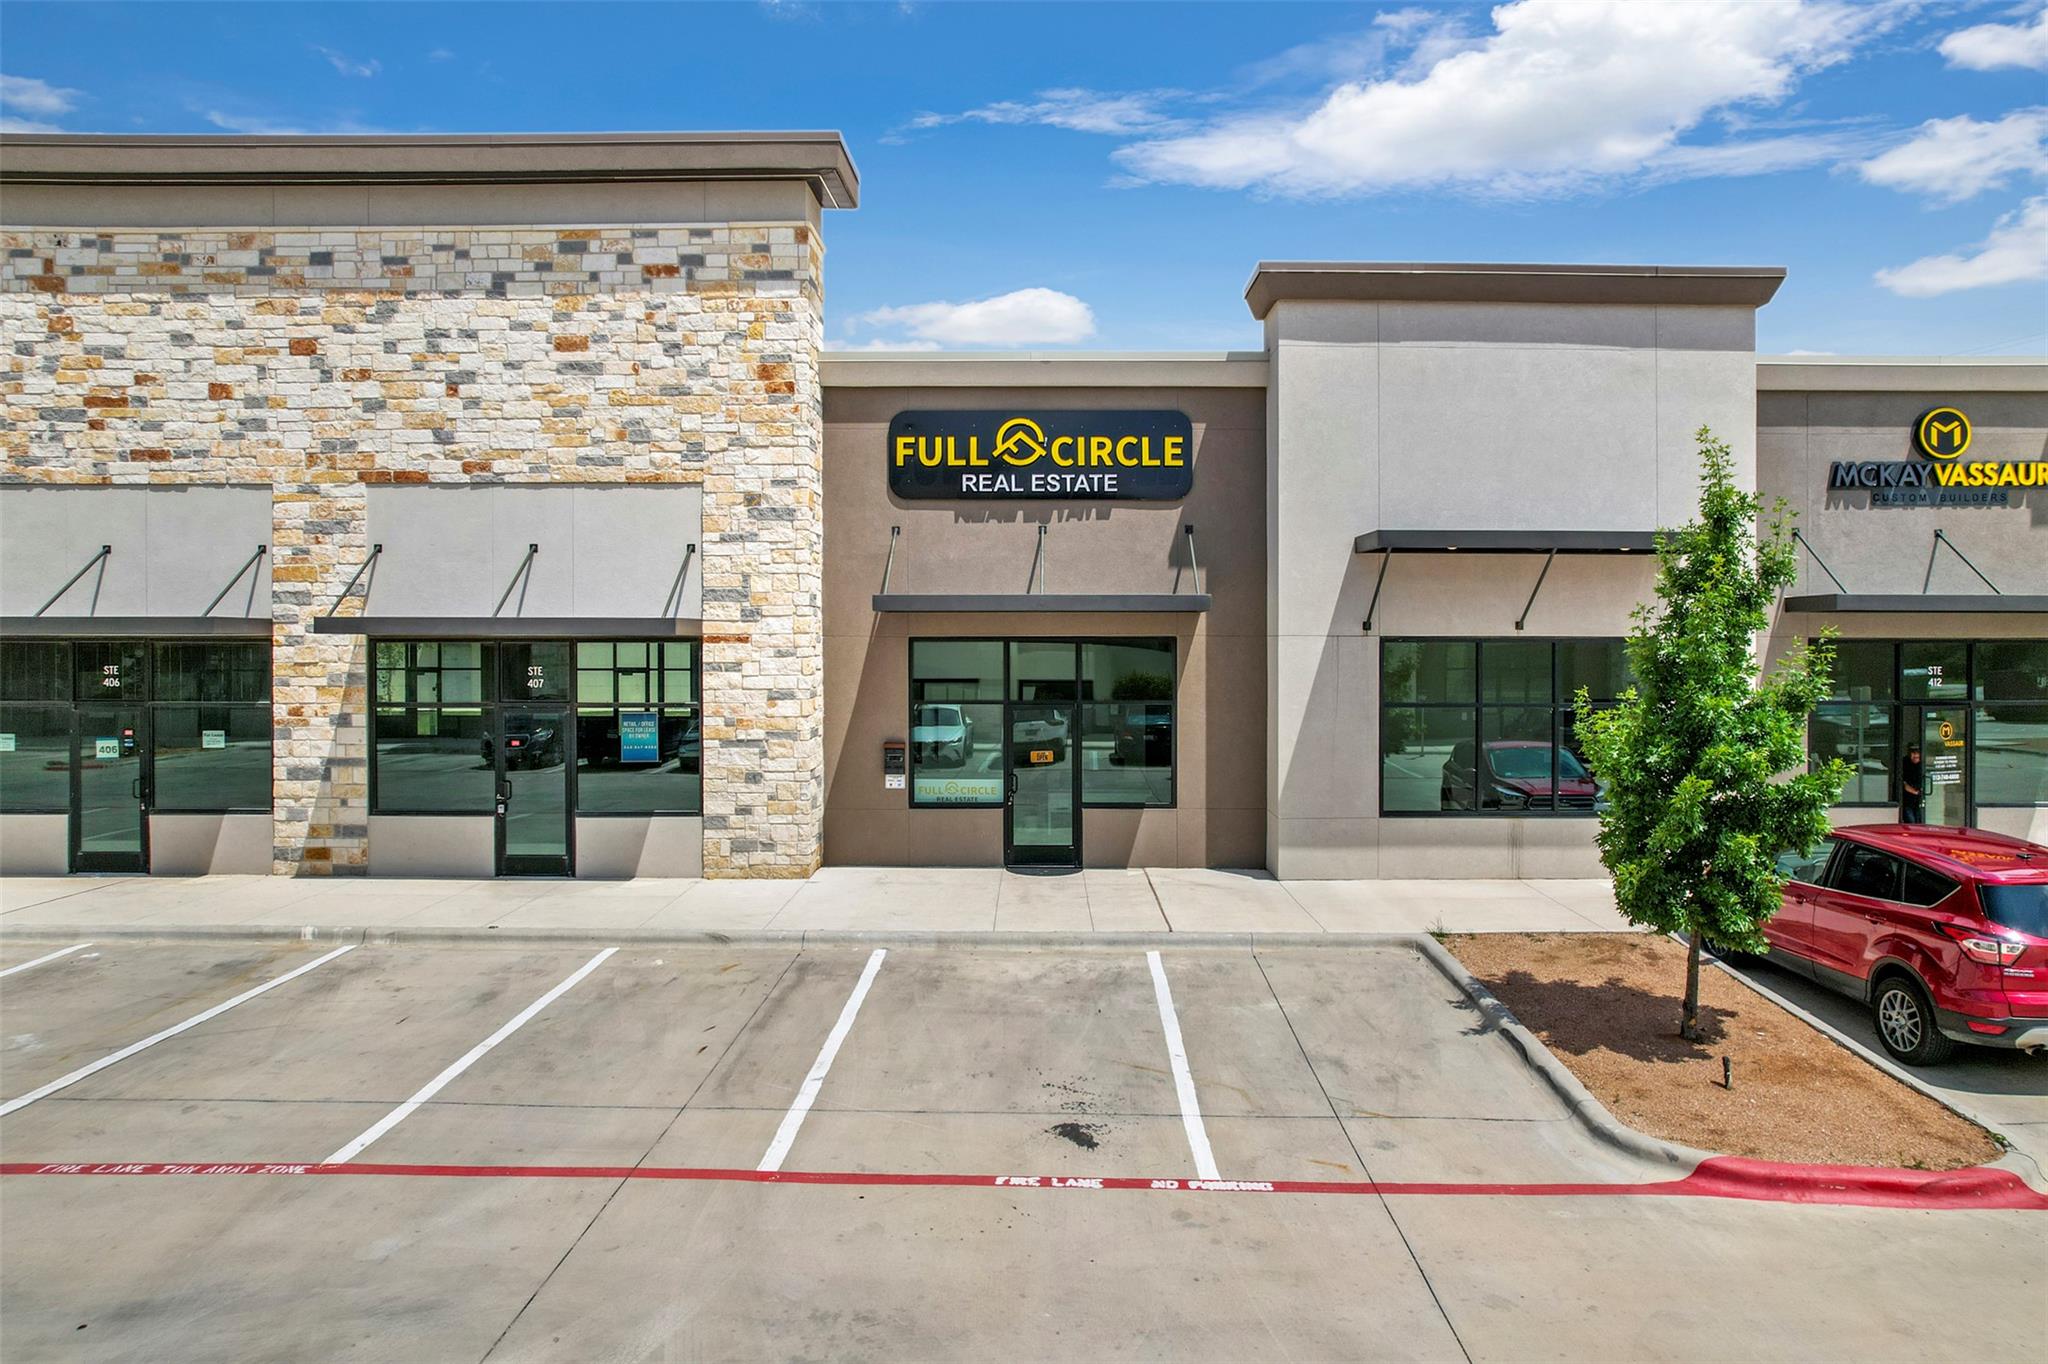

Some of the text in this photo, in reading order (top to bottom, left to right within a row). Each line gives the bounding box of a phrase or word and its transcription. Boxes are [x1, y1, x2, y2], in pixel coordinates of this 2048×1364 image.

[895, 436, 1184, 467] FULL CIRCLE
[1834, 463, 1933, 487] MCKAY
[961, 474, 1118, 492] REAL ESTATE
[1872, 492, 2008, 503] CUSTOM BUILDERS
[103, 666, 119, 675] STE
[527, 666, 543, 676] STE
[1927, 666, 1943, 675] STE
[103, 678, 120, 687] 406
[527, 679, 544, 688] 407
[1928, 678, 1943, 687] 412
[99, 745, 118, 753] 406
[918, 786, 997, 796] FULL CIRCLE
[37, 1164, 90, 1173] FIRE
[92, 1164, 152, 1173] LANE
[257, 1165, 312, 1174] ZONE
[1051, 1178, 1104, 1188] LANE
